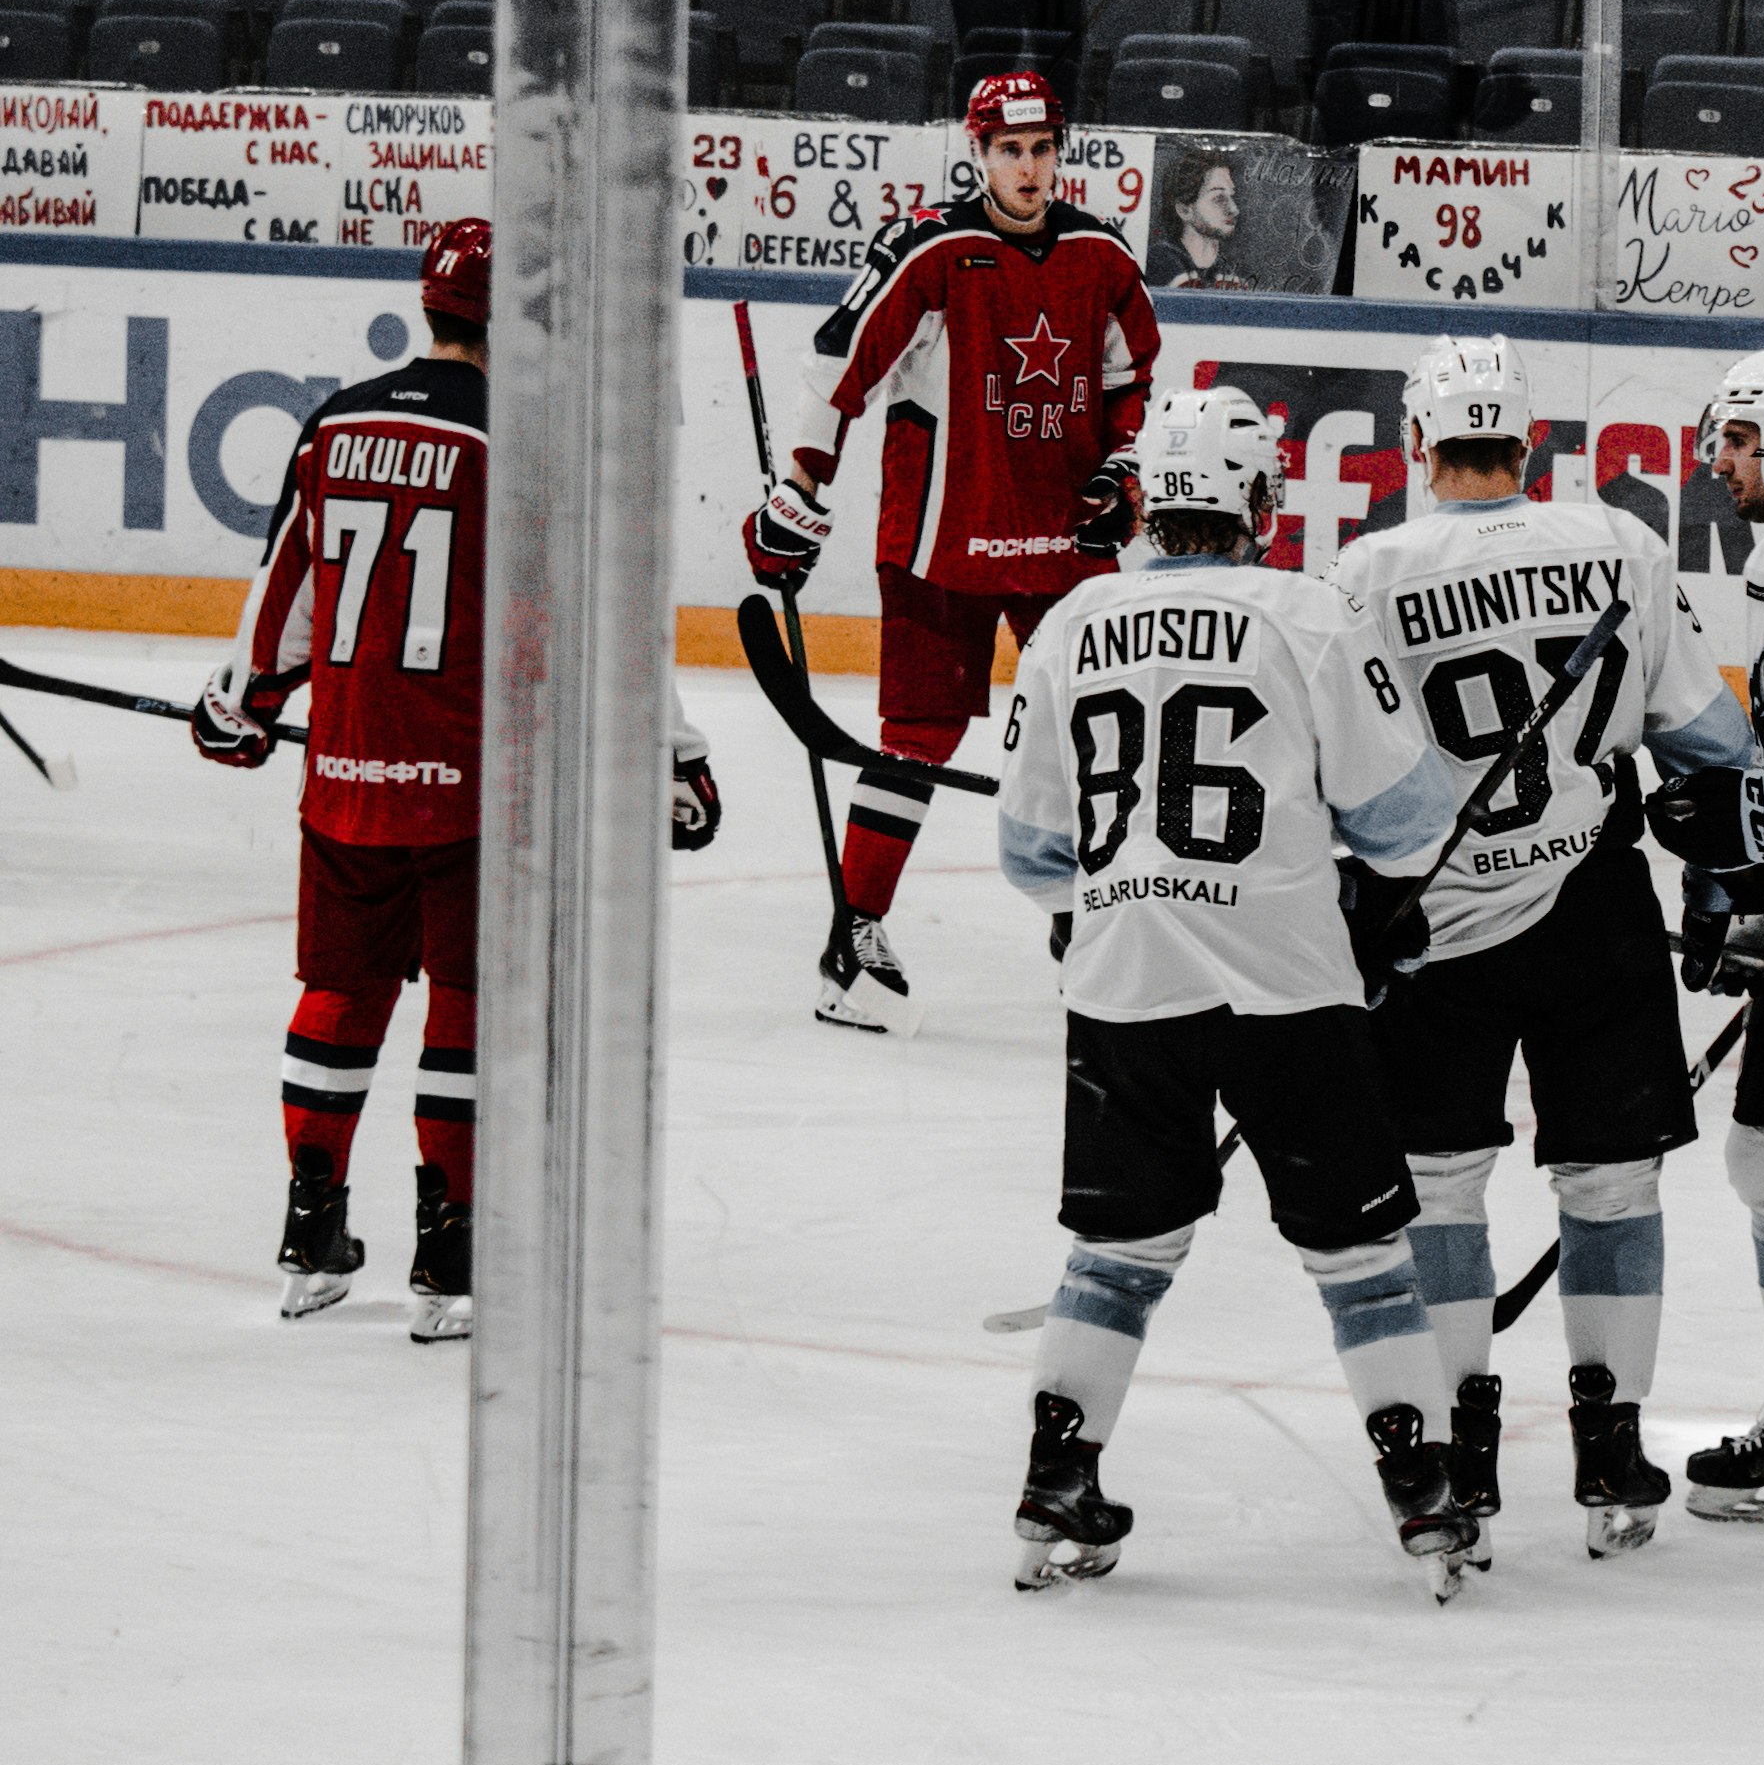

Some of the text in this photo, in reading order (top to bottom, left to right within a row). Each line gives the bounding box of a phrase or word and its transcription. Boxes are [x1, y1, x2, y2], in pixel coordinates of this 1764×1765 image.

[0, 92, 108, 134] ИКОЛАЙ,
[345, 102, 466, 135] САМОРУКОВ
[1, 143, 88, 178] ДАВАЙ
[368, 140, 495, 173] ЗАЩИЩАЕ
[693, 134, 743, 170] 23
[793, 134, 890, 172] BEST
[1118, 167, 1145, 214] 9
[1393, 155, 1531, 188] МАМИН
[0, 187, 97, 227] АБИВАЙ
[344, 176, 422, 216] ЦСКА
[1617, 166, 1754, 237] Mario
[269, 218, 318, 243] ВАС
[341, 219, 375, 246] НЕ
[1435, 203, 1483, 250] 98
[436, 249, 460, 277] 71
[745, 233, 867, 269] DEFENSE
[1616, 237, 1758, 315] Kempe
[1467, 403, 1502, 429] 97
[326, 433, 462, 492] OKULOV
[1163, 470, 1194, 497] 86
[1476, 520, 1527, 535] LUTCH
[321, 494, 458, 674] 71
[1395, 558, 1624, 647] BUINITSKY
[1075, 608, 1251, 675] ANOSOV
[1420, 633, 1630, 838] 97
[1069, 678, 1272, 878] 86
[1082, 876, 1240, 913] BELARUSKALI
